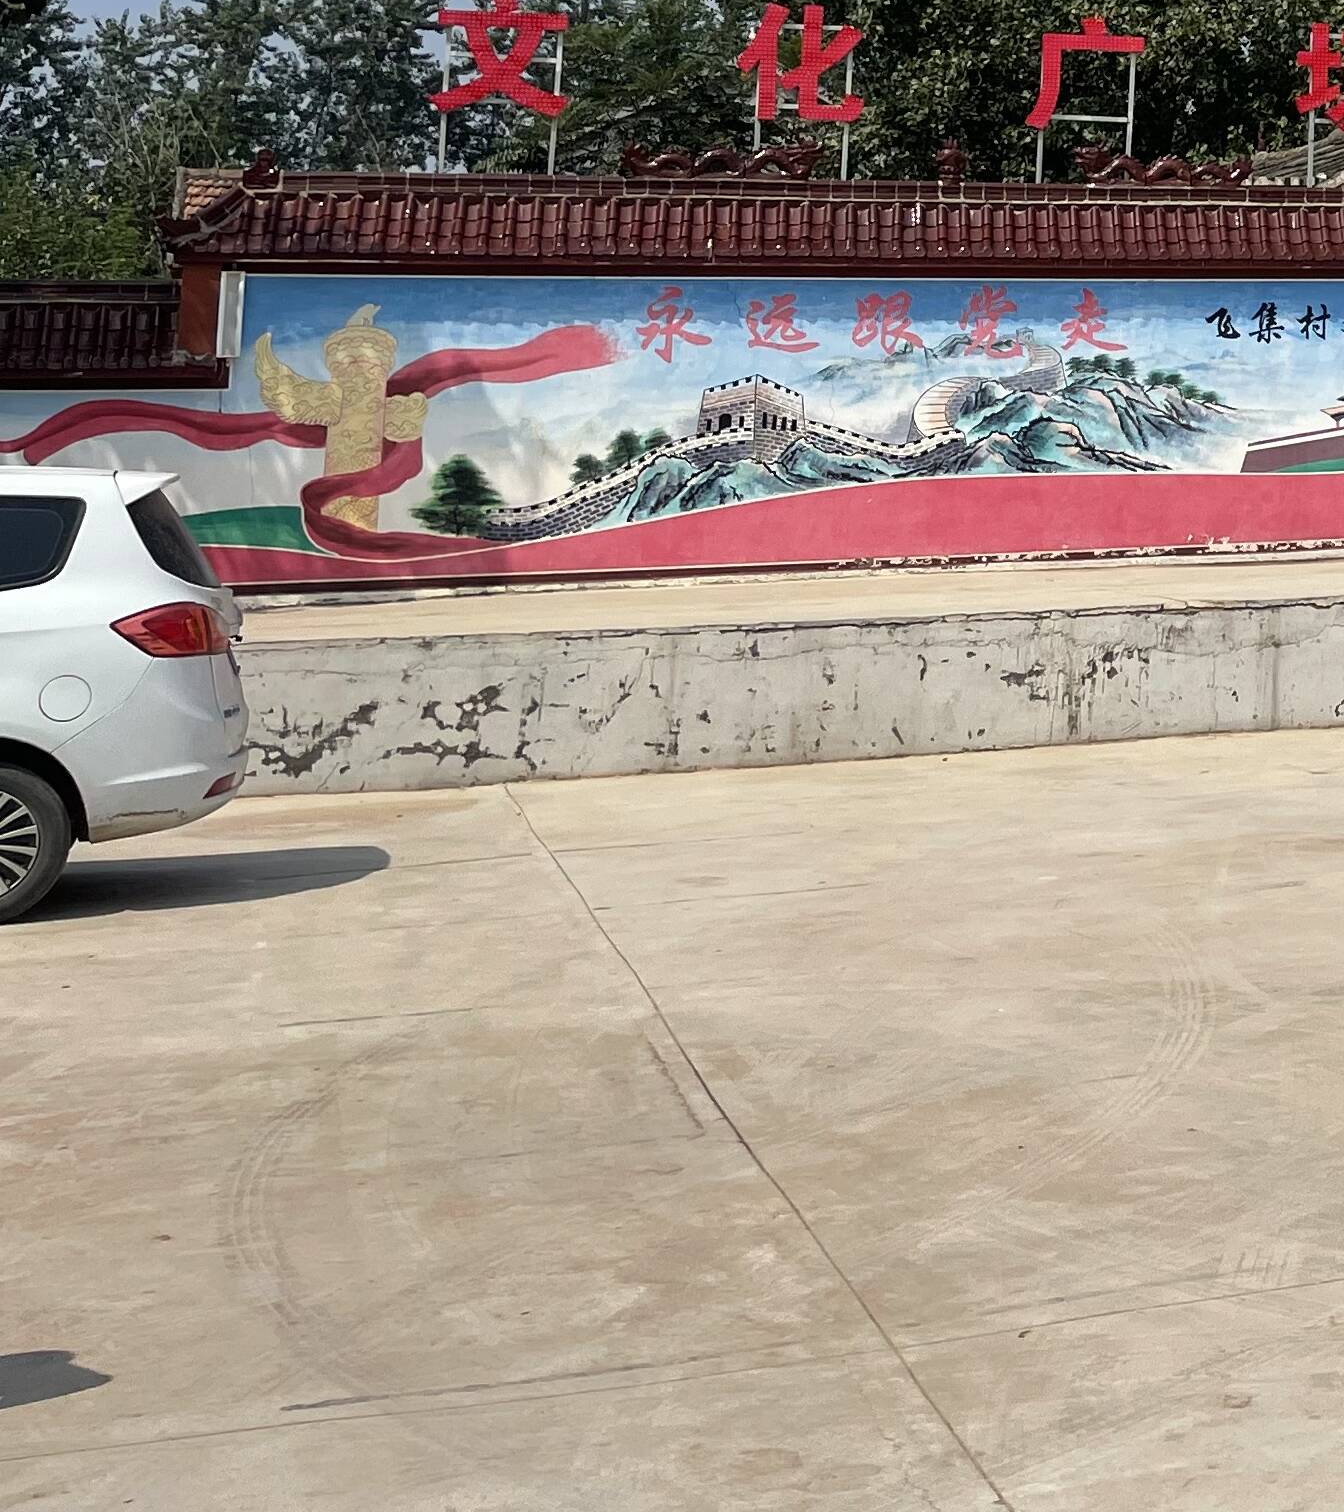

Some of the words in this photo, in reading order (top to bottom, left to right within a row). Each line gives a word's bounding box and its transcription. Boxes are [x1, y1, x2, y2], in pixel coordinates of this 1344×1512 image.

[635, 284, 1129, 364] 永远跟党走
